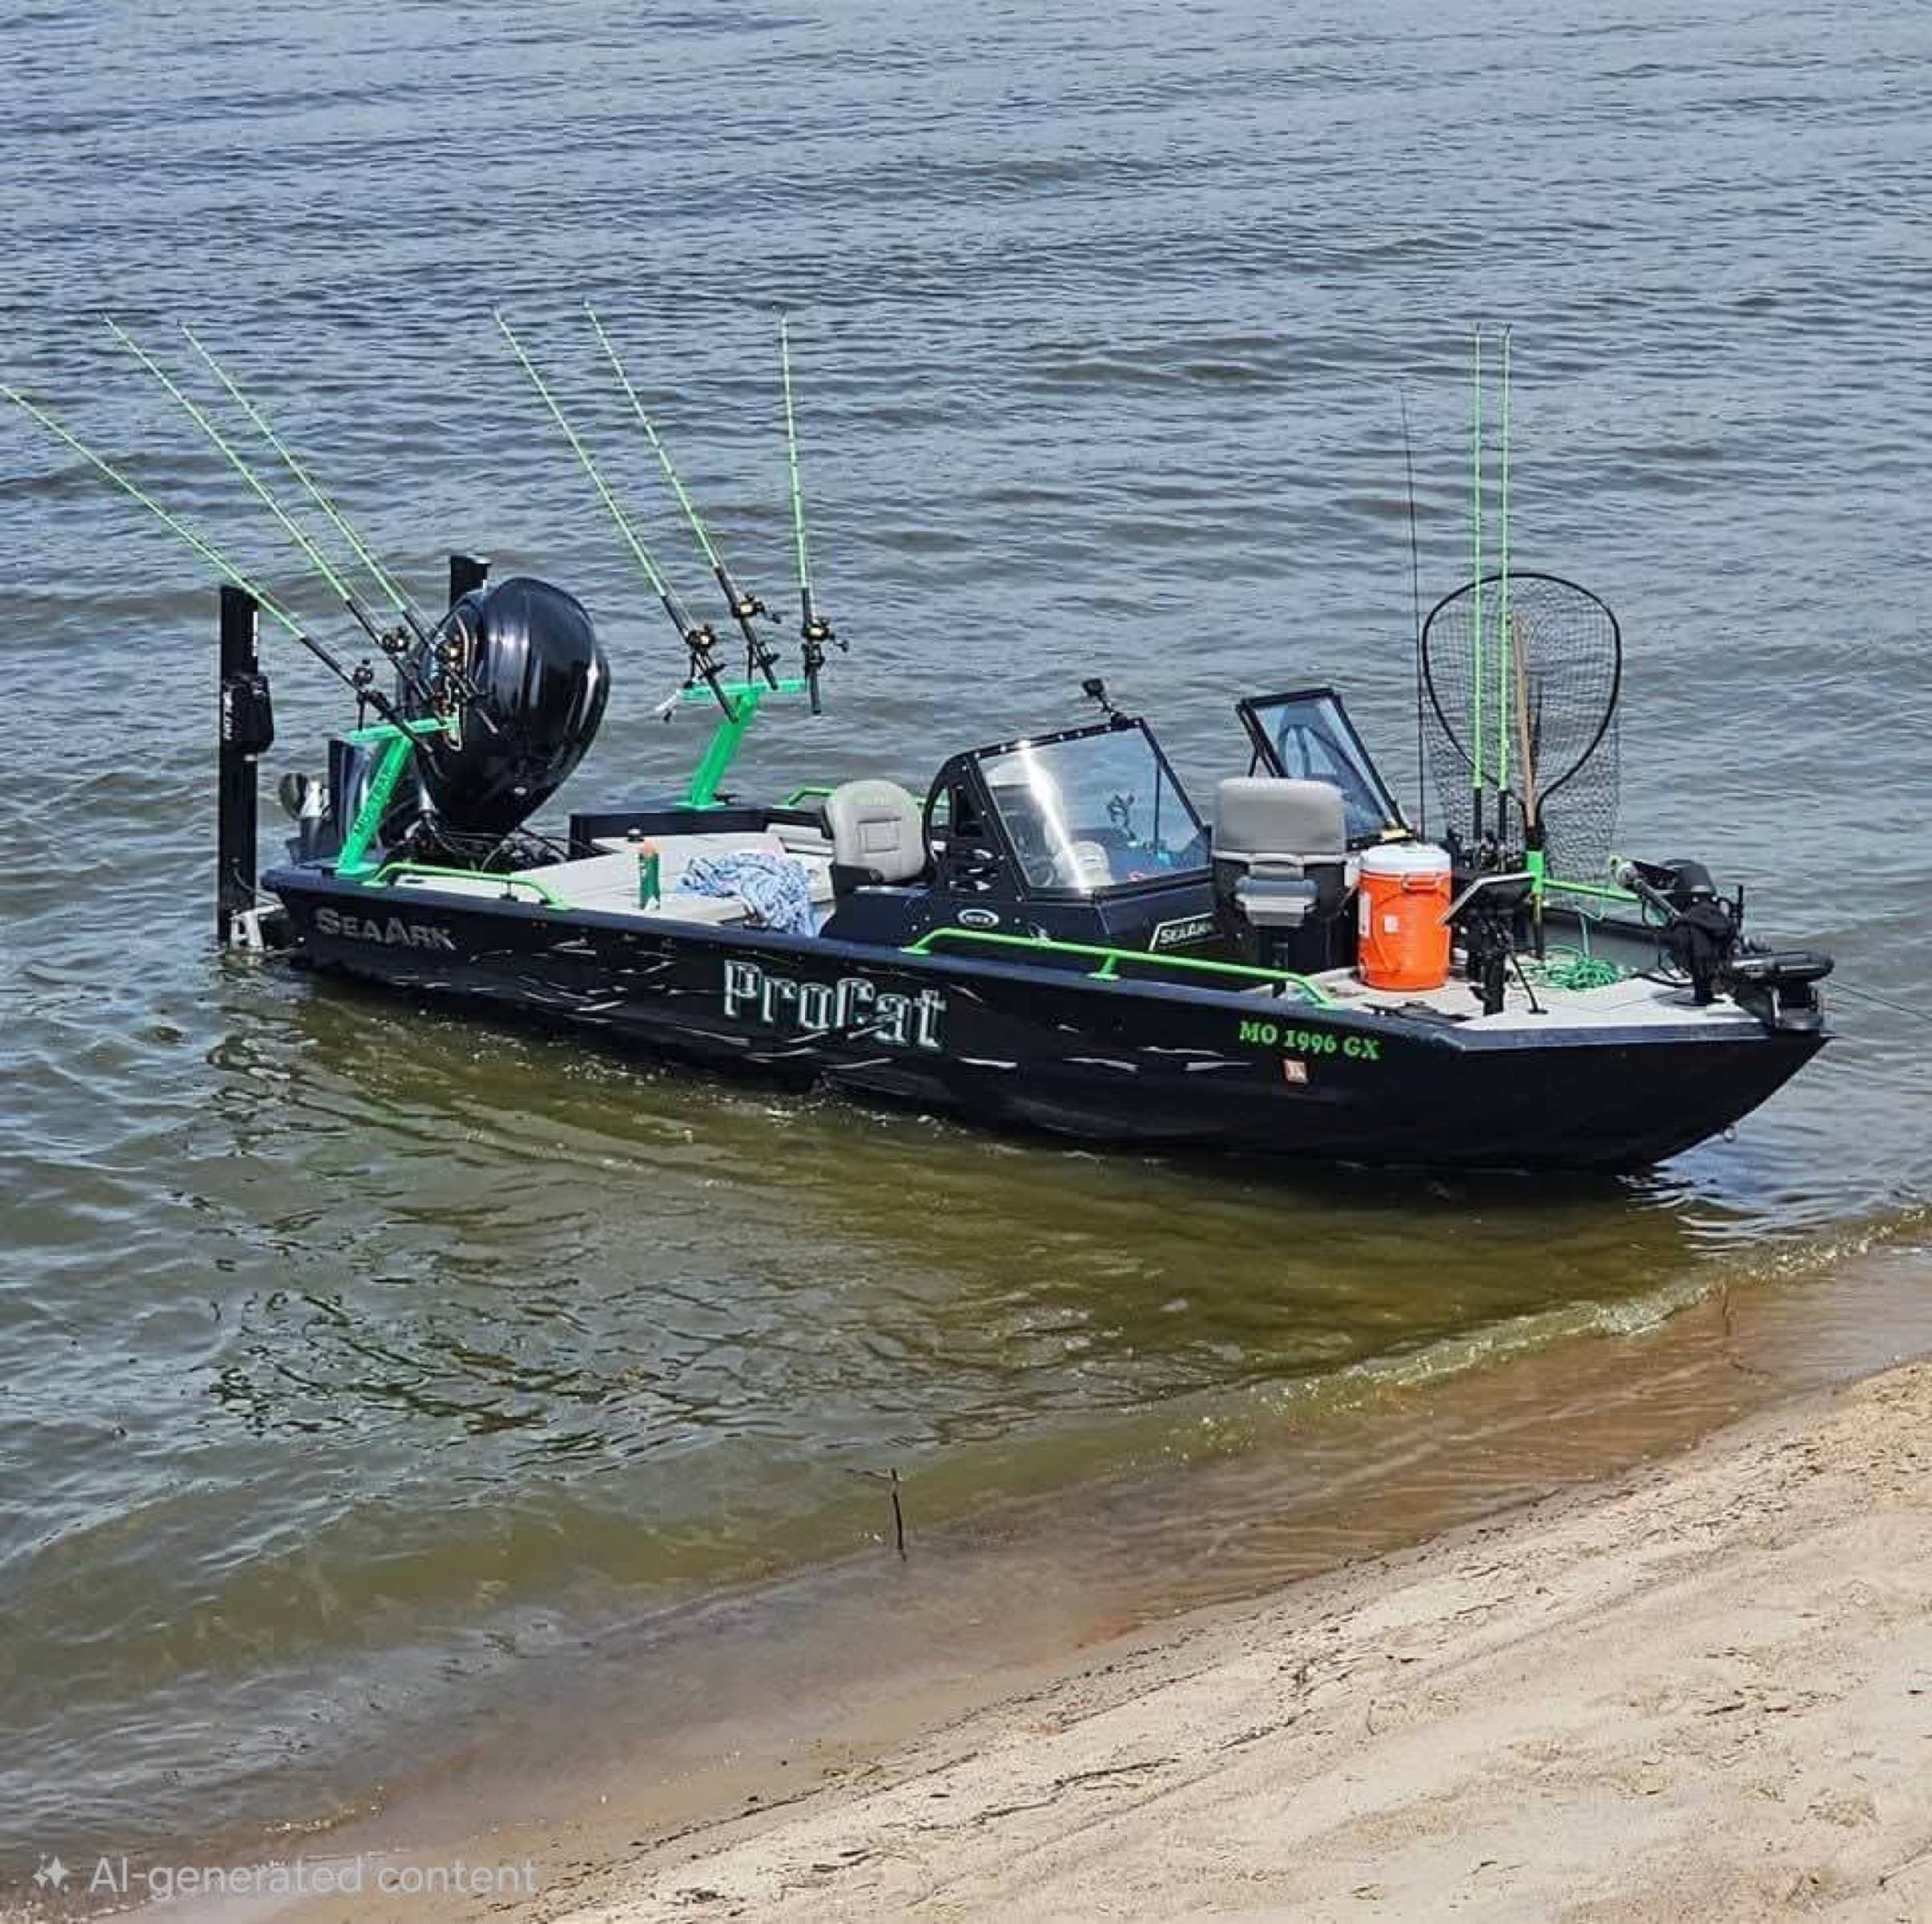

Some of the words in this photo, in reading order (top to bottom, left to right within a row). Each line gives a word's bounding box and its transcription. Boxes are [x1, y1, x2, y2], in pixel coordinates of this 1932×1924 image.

[724, 960, 947, 1049] ProCat
[1239, 1020, 1278, 1044] MO
[1283, 1030, 1338, 1054] 1996
[1343, 1036, 1381, 1060] GX
